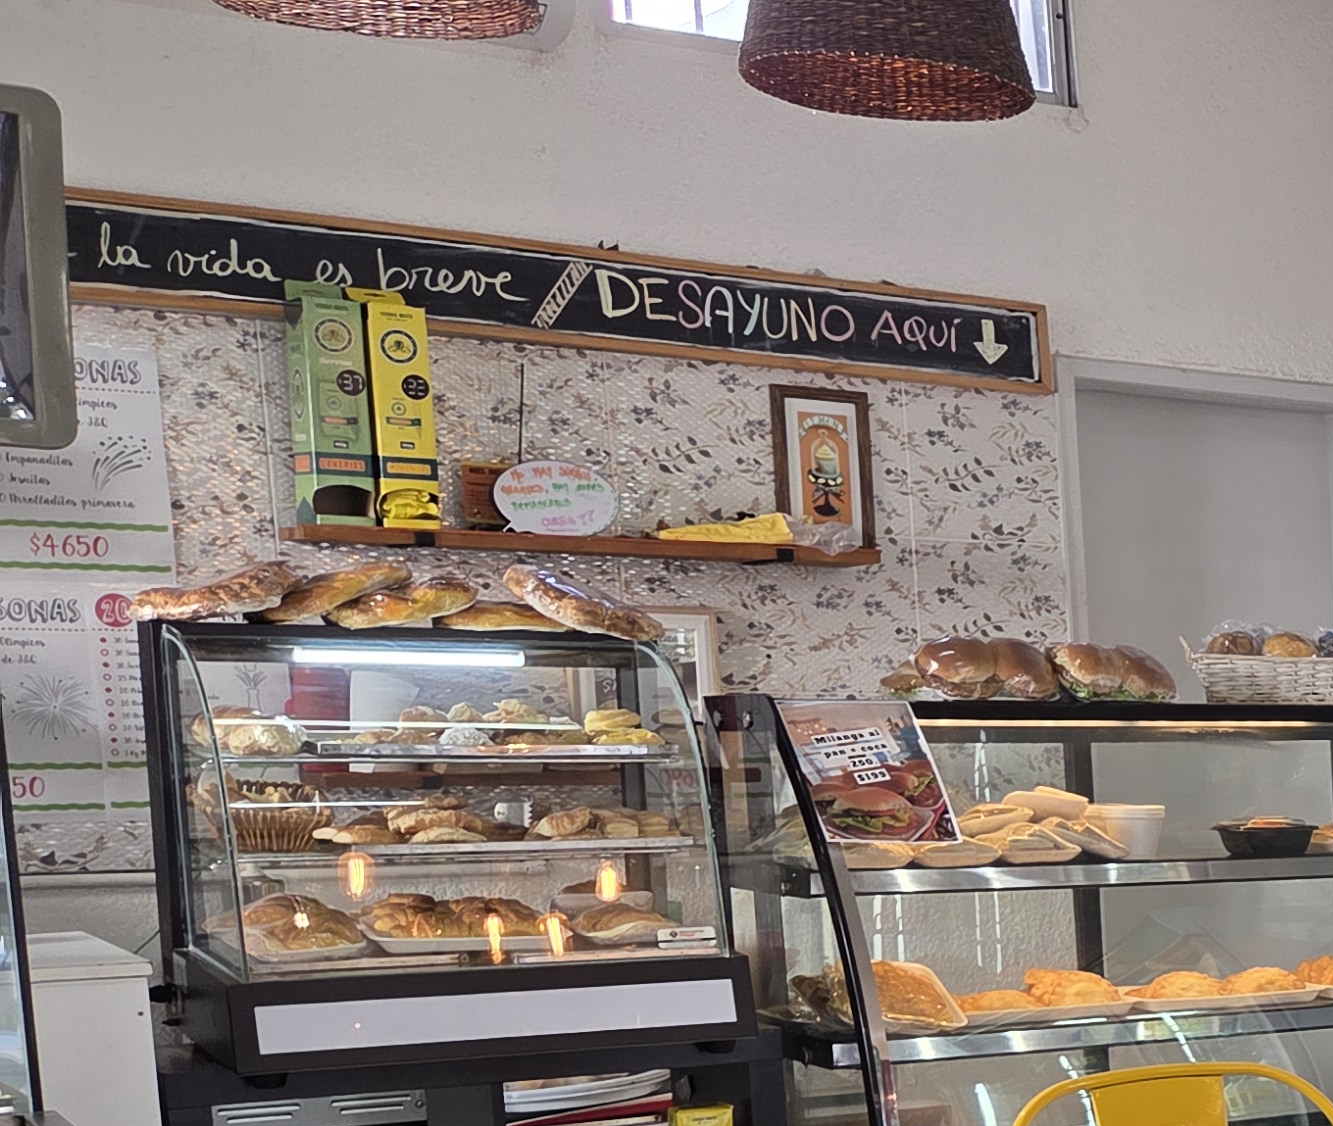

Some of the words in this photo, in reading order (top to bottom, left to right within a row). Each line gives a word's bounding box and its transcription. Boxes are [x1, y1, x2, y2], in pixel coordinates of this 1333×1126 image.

[97, 222, 152, 268] la
[167, 239, 283, 281] vida
[316, 259, 354, 291] es
[377, 248, 531, 301] breve
[595, 268, 856, 342] DESAYUNO
[74, 358, 142, 385] ONAS
[78, 398, 118, 411] impicos
[29, 532, 110, 558] $4650
[814, 731, 865, 746] Milanga
[823, 747, 846, 760] pan
[860, 742, 889, 753] coca
[12, 776, 46, 799] 50
[856, 769, 888, 783] $199
